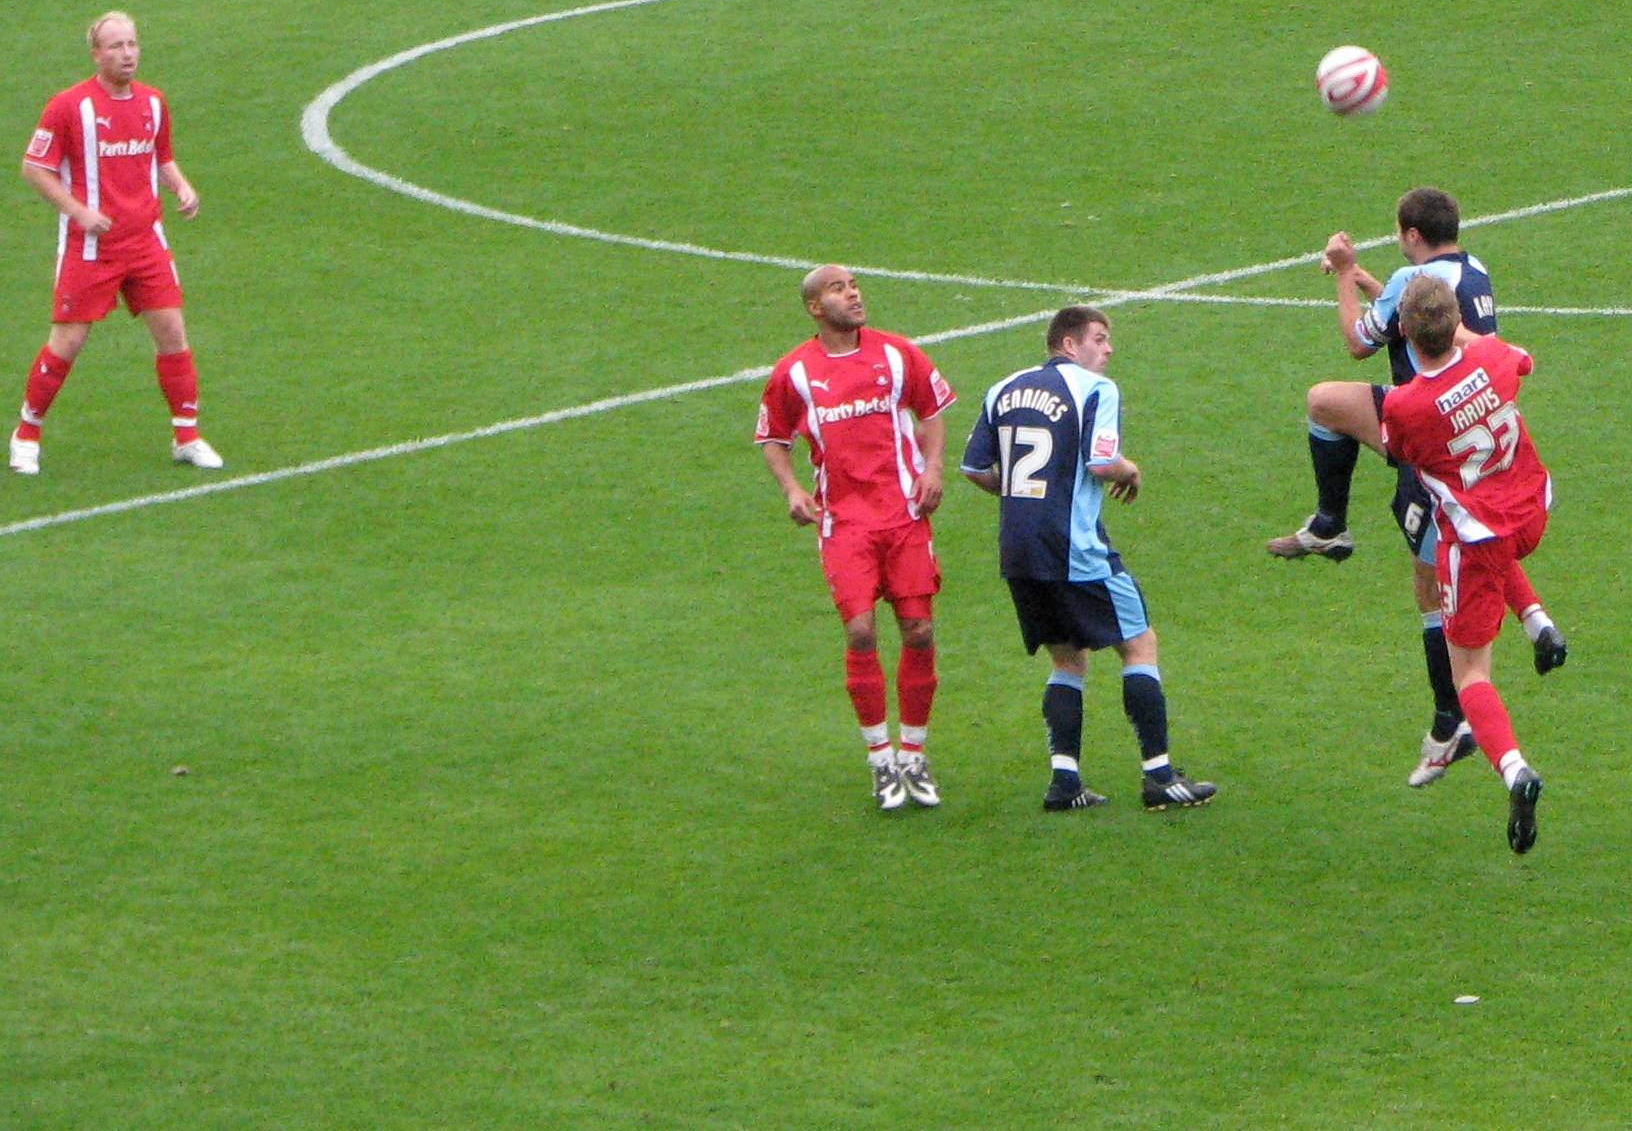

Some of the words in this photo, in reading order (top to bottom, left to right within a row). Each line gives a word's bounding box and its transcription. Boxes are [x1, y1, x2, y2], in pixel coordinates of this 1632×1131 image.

[997, 388, 1068, 423] JENNINGS
[1437, 371, 1488, 412] haart
[1450, 387, 1501, 434] JARVIS
[998, 426, 1053, 499] 12
